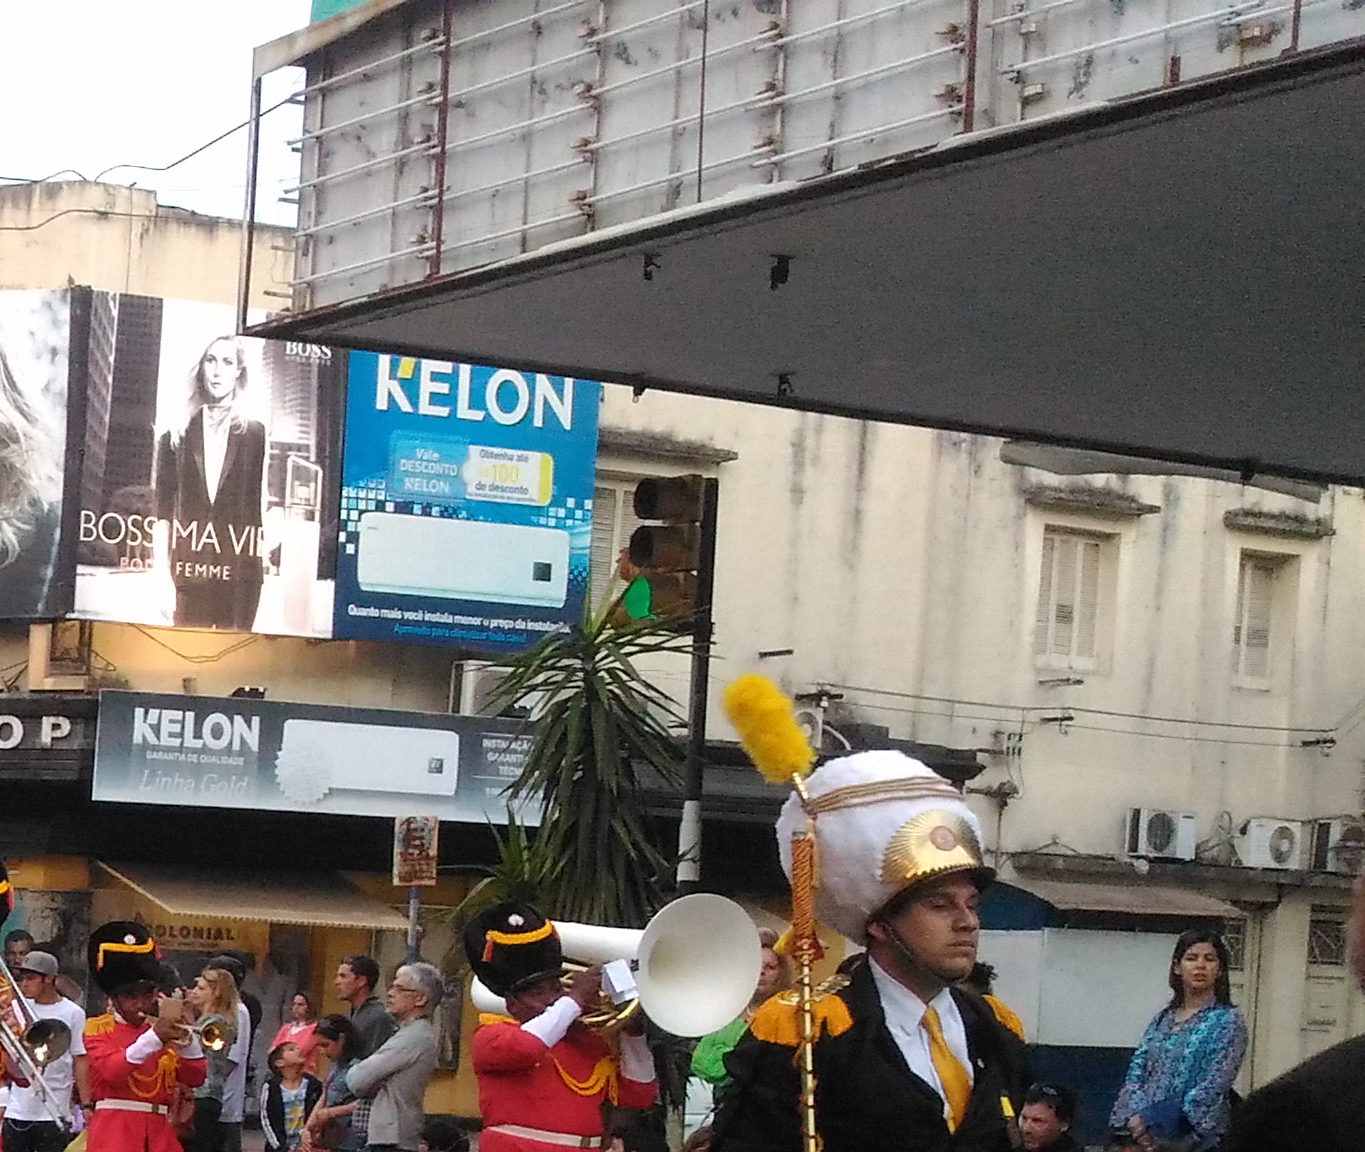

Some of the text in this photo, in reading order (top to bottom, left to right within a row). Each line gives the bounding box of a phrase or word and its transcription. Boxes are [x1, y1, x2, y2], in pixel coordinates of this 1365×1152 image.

[375, 353, 574, 431] KELON
[400, 459, 458, 476] DESCONTO
[404, 476, 449, 493] KELON
[171, 519, 221, 554] MA
[175, 561, 232, 581] FEMME
[133, 706, 261, 752] KELON
[139, 769, 195, 791] Linha
[150, 924, 236, 941] OLONIAL
